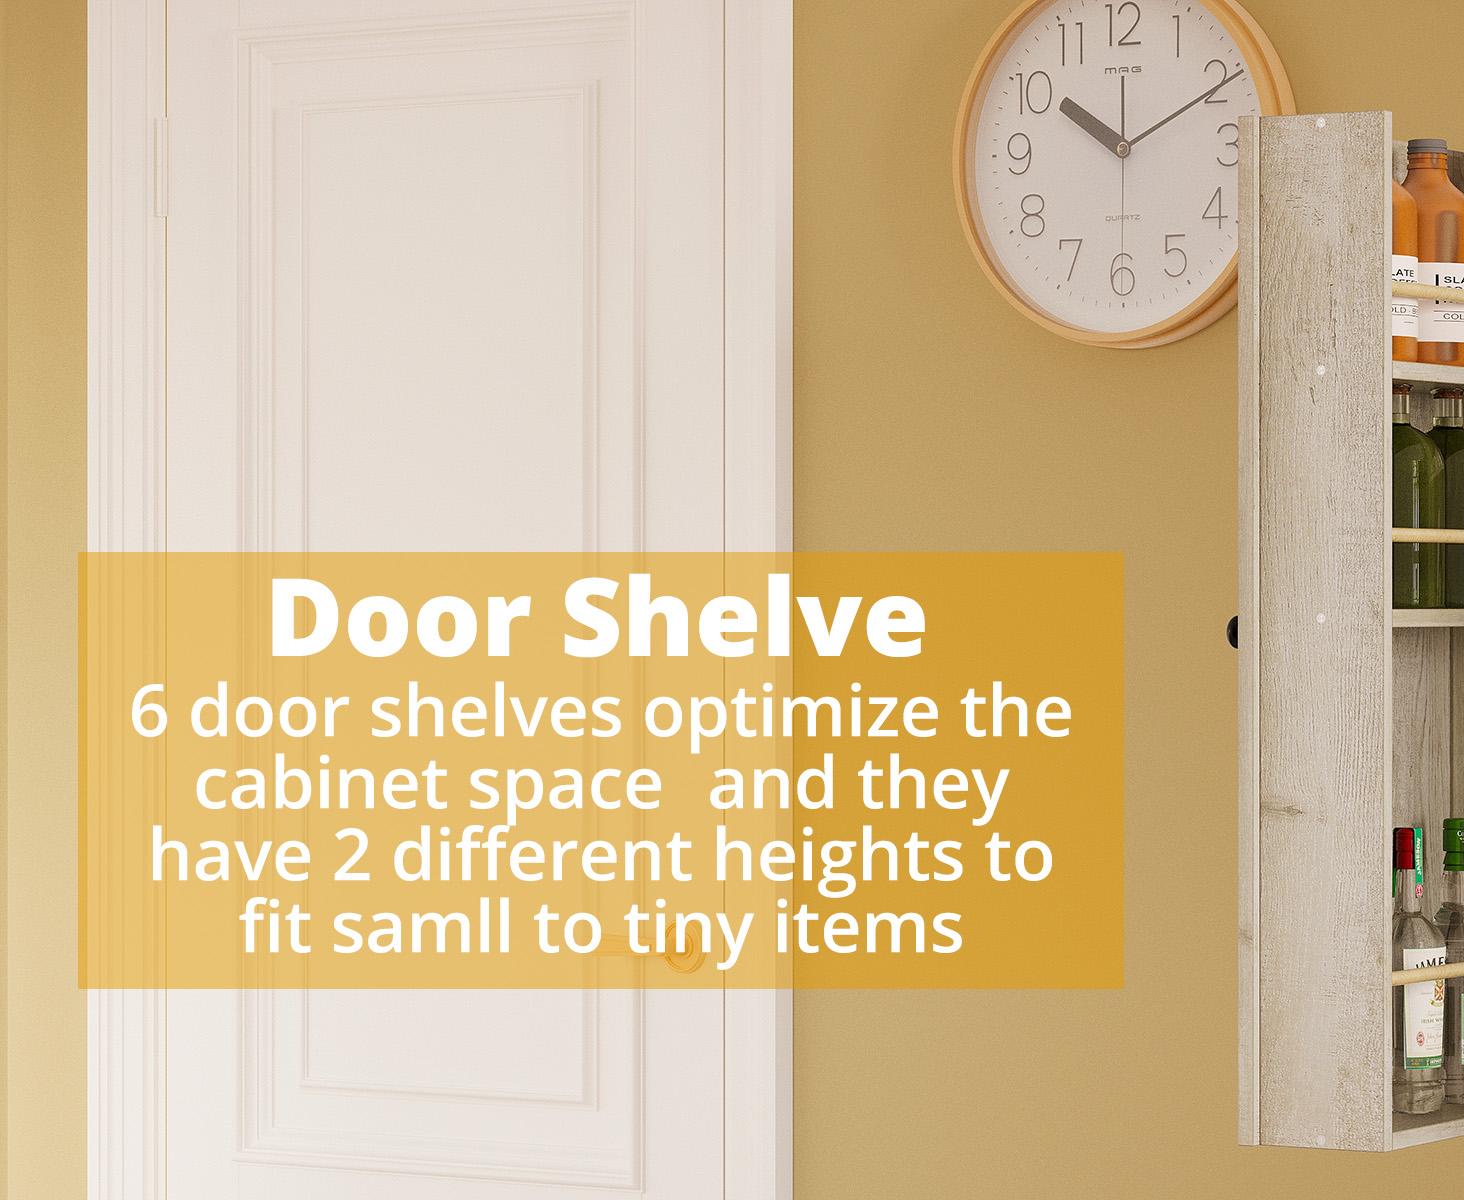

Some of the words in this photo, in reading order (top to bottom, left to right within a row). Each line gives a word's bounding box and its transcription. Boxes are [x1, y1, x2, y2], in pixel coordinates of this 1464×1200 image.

[1057, 21, 1084, 66] 11
[1104, 1, 1142, 47] 12
[1171, 14, 1181, 59] 1
[1014, 70, 1053, 115] 10
[1203, 59, 1228, 104] 2
[1006, 132, 1033, 176] 9
[1216, 123, 1238, 167] 3
[1019, 193, 1046, 238] 8
[1201, 186, 1229, 230] 4
[1058, 238, 1084, 282] 7
[1109, 252, 1136, 297] 6
[1163, 233, 1189, 279] 5
